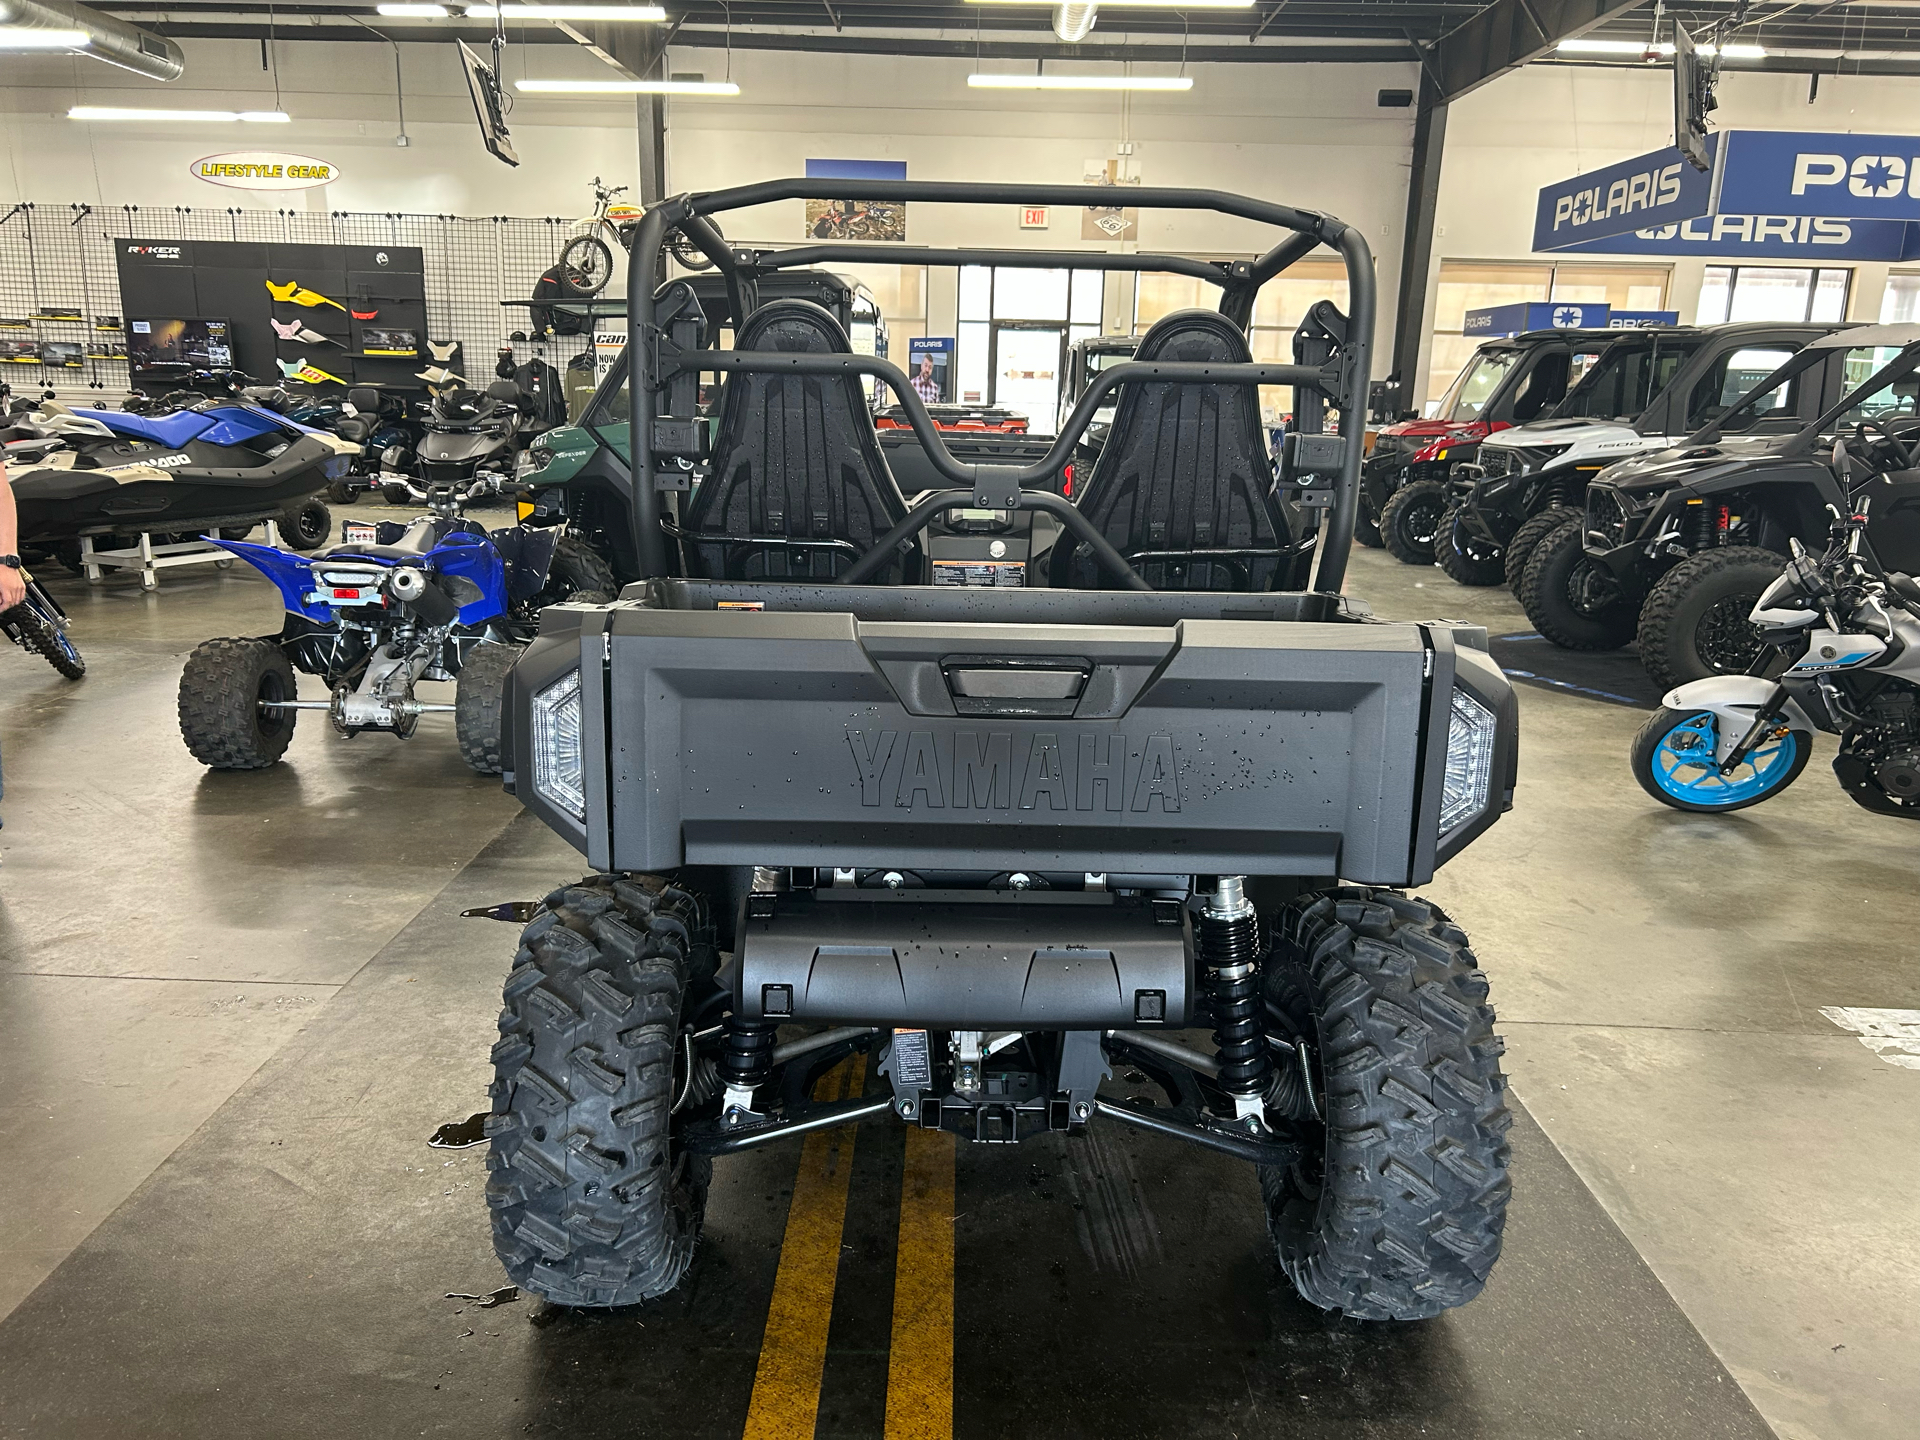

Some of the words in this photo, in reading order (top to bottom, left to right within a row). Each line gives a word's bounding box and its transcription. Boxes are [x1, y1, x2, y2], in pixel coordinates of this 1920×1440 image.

[201, 163, 283, 178] LIFESTYLE
[287, 165, 330, 179] GEAR
[1791, 153, 1920, 198] PO
[1553, 162, 1683, 231] POLARIS
[1026, 209, 1045, 224] EXIT
[128, 246, 180, 255] RYKER
[1465, 314, 1492, 329] POLARIS
[598, 354, 616, 364] NOW
[599, 364, 607, 374] IS
[1598, 441, 1643, 449] 1500
[846, 730, 1181, 812] YAMAHA
